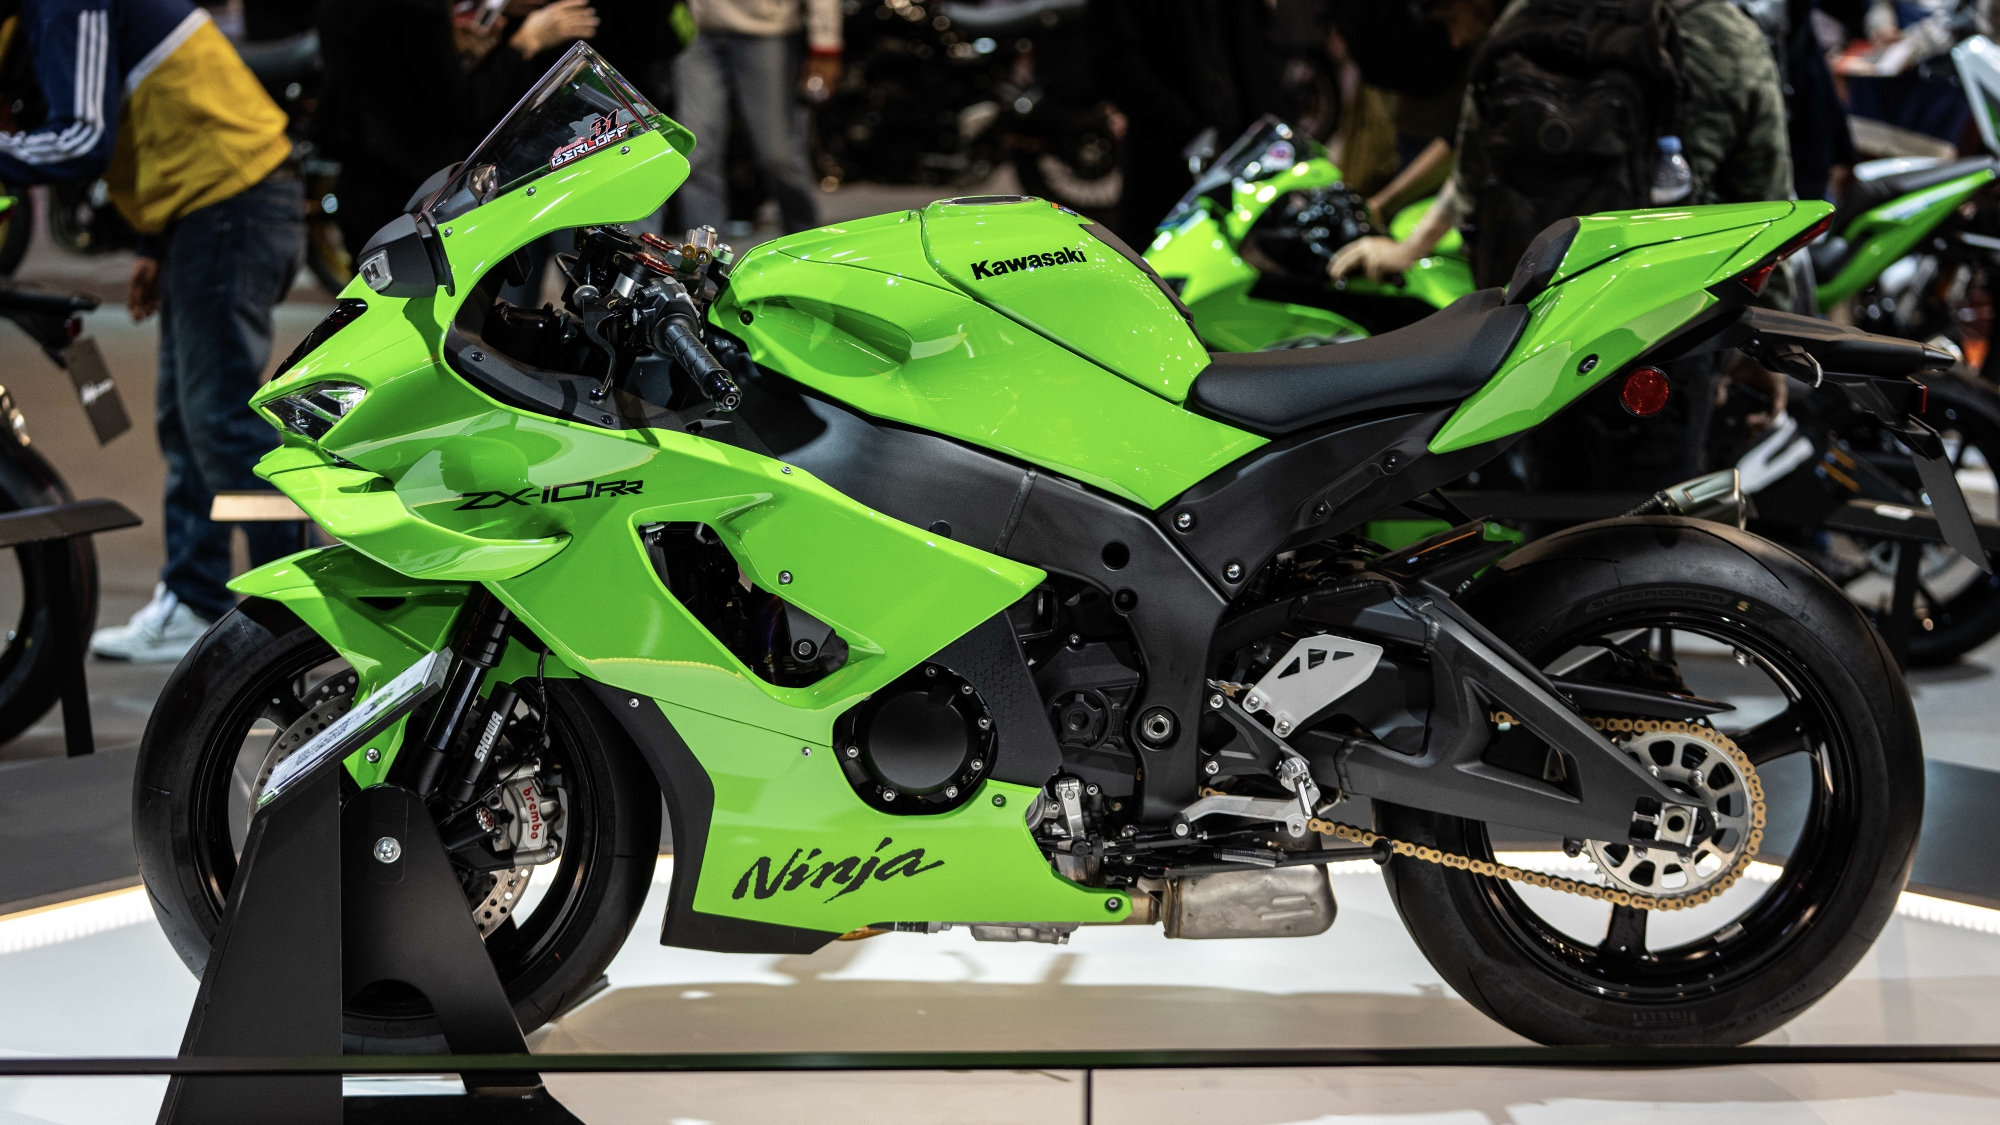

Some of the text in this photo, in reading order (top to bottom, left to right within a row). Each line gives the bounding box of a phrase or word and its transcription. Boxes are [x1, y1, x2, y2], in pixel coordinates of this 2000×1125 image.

[551, 123, 629, 168] GERLOFF
[590, 109, 619, 142] 31
[970, 246, 1087, 280] Kawasaki
[453, 480, 643, 511] ZX-10RR
[474, 711, 503, 762] SHOWA
[522, 786, 542, 840] brembo
[732, 837, 945, 904] Ninja
